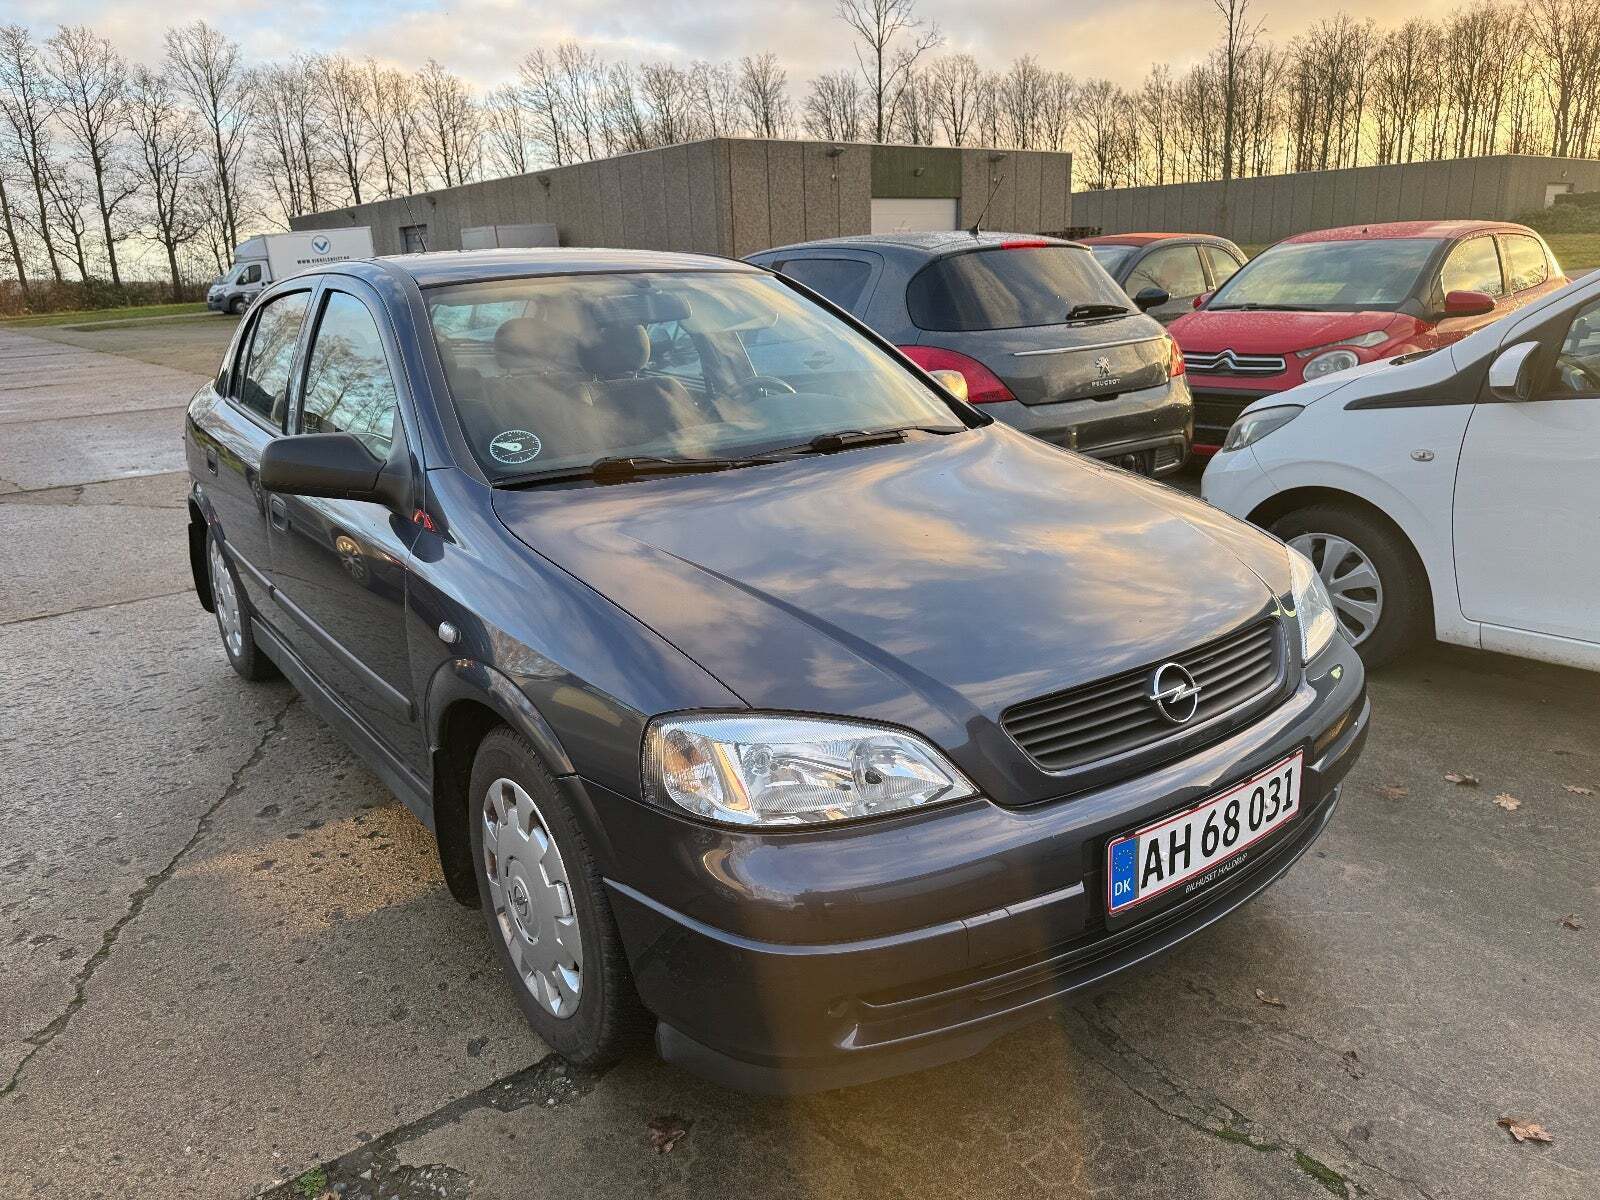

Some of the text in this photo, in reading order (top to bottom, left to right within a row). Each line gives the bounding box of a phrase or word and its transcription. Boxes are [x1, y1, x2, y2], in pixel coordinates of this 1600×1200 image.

[1091, 378, 1121, 387] PEUGEOT
[1141, 767, 1294, 890] AH 68 031
[1114, 877, 1132, 897] DK
[1184, 869, 1218, 894] BILHUSET
